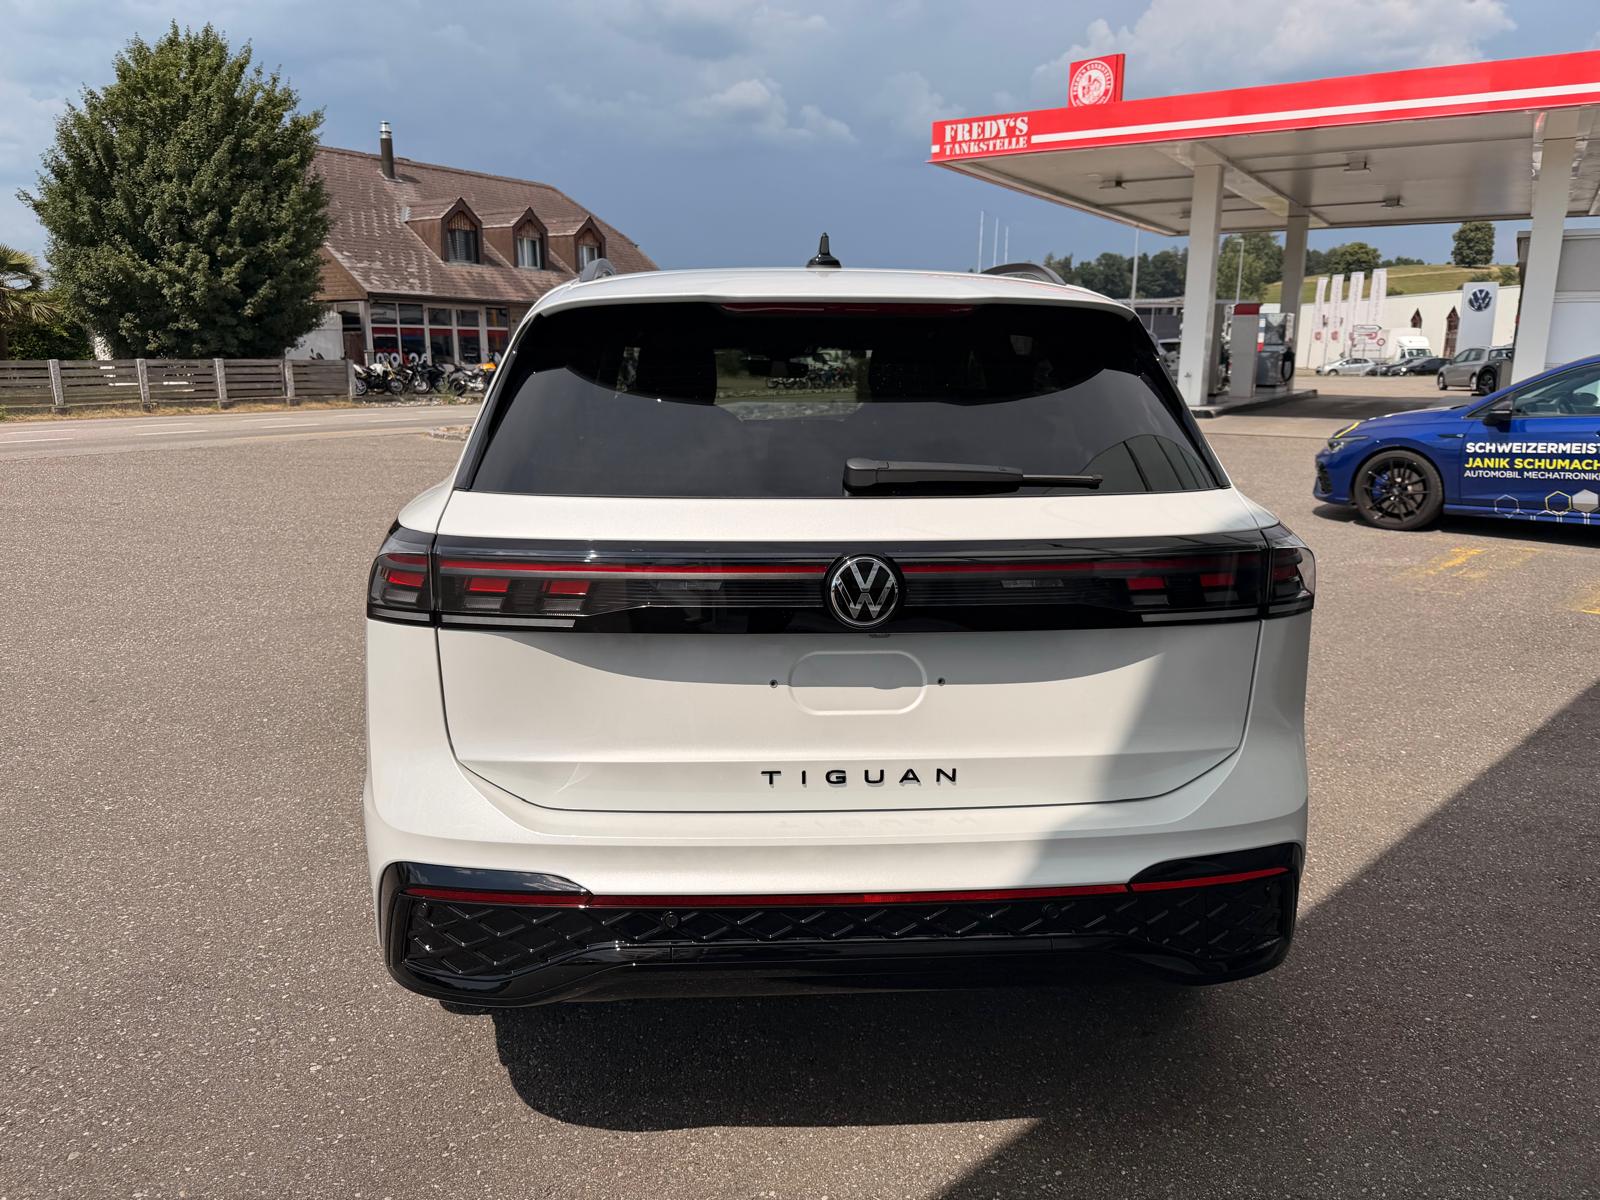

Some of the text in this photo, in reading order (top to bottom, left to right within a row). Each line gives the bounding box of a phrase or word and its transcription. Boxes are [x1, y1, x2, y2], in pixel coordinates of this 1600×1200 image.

[944, 117, 1028, 143] FREDY'S
[944, 136, 1028, 155] TANKSTELLE
[1469, 289, 1492, 311] VW
[1465, 457, 1600, 471] JANIK SCHUMACH
[1464, 470, 1600, 481] AUTOMOBIL MECHATRONIK
[835, 559, 897, 621] VW
[760, 768, 957, 787] TIGUAN
